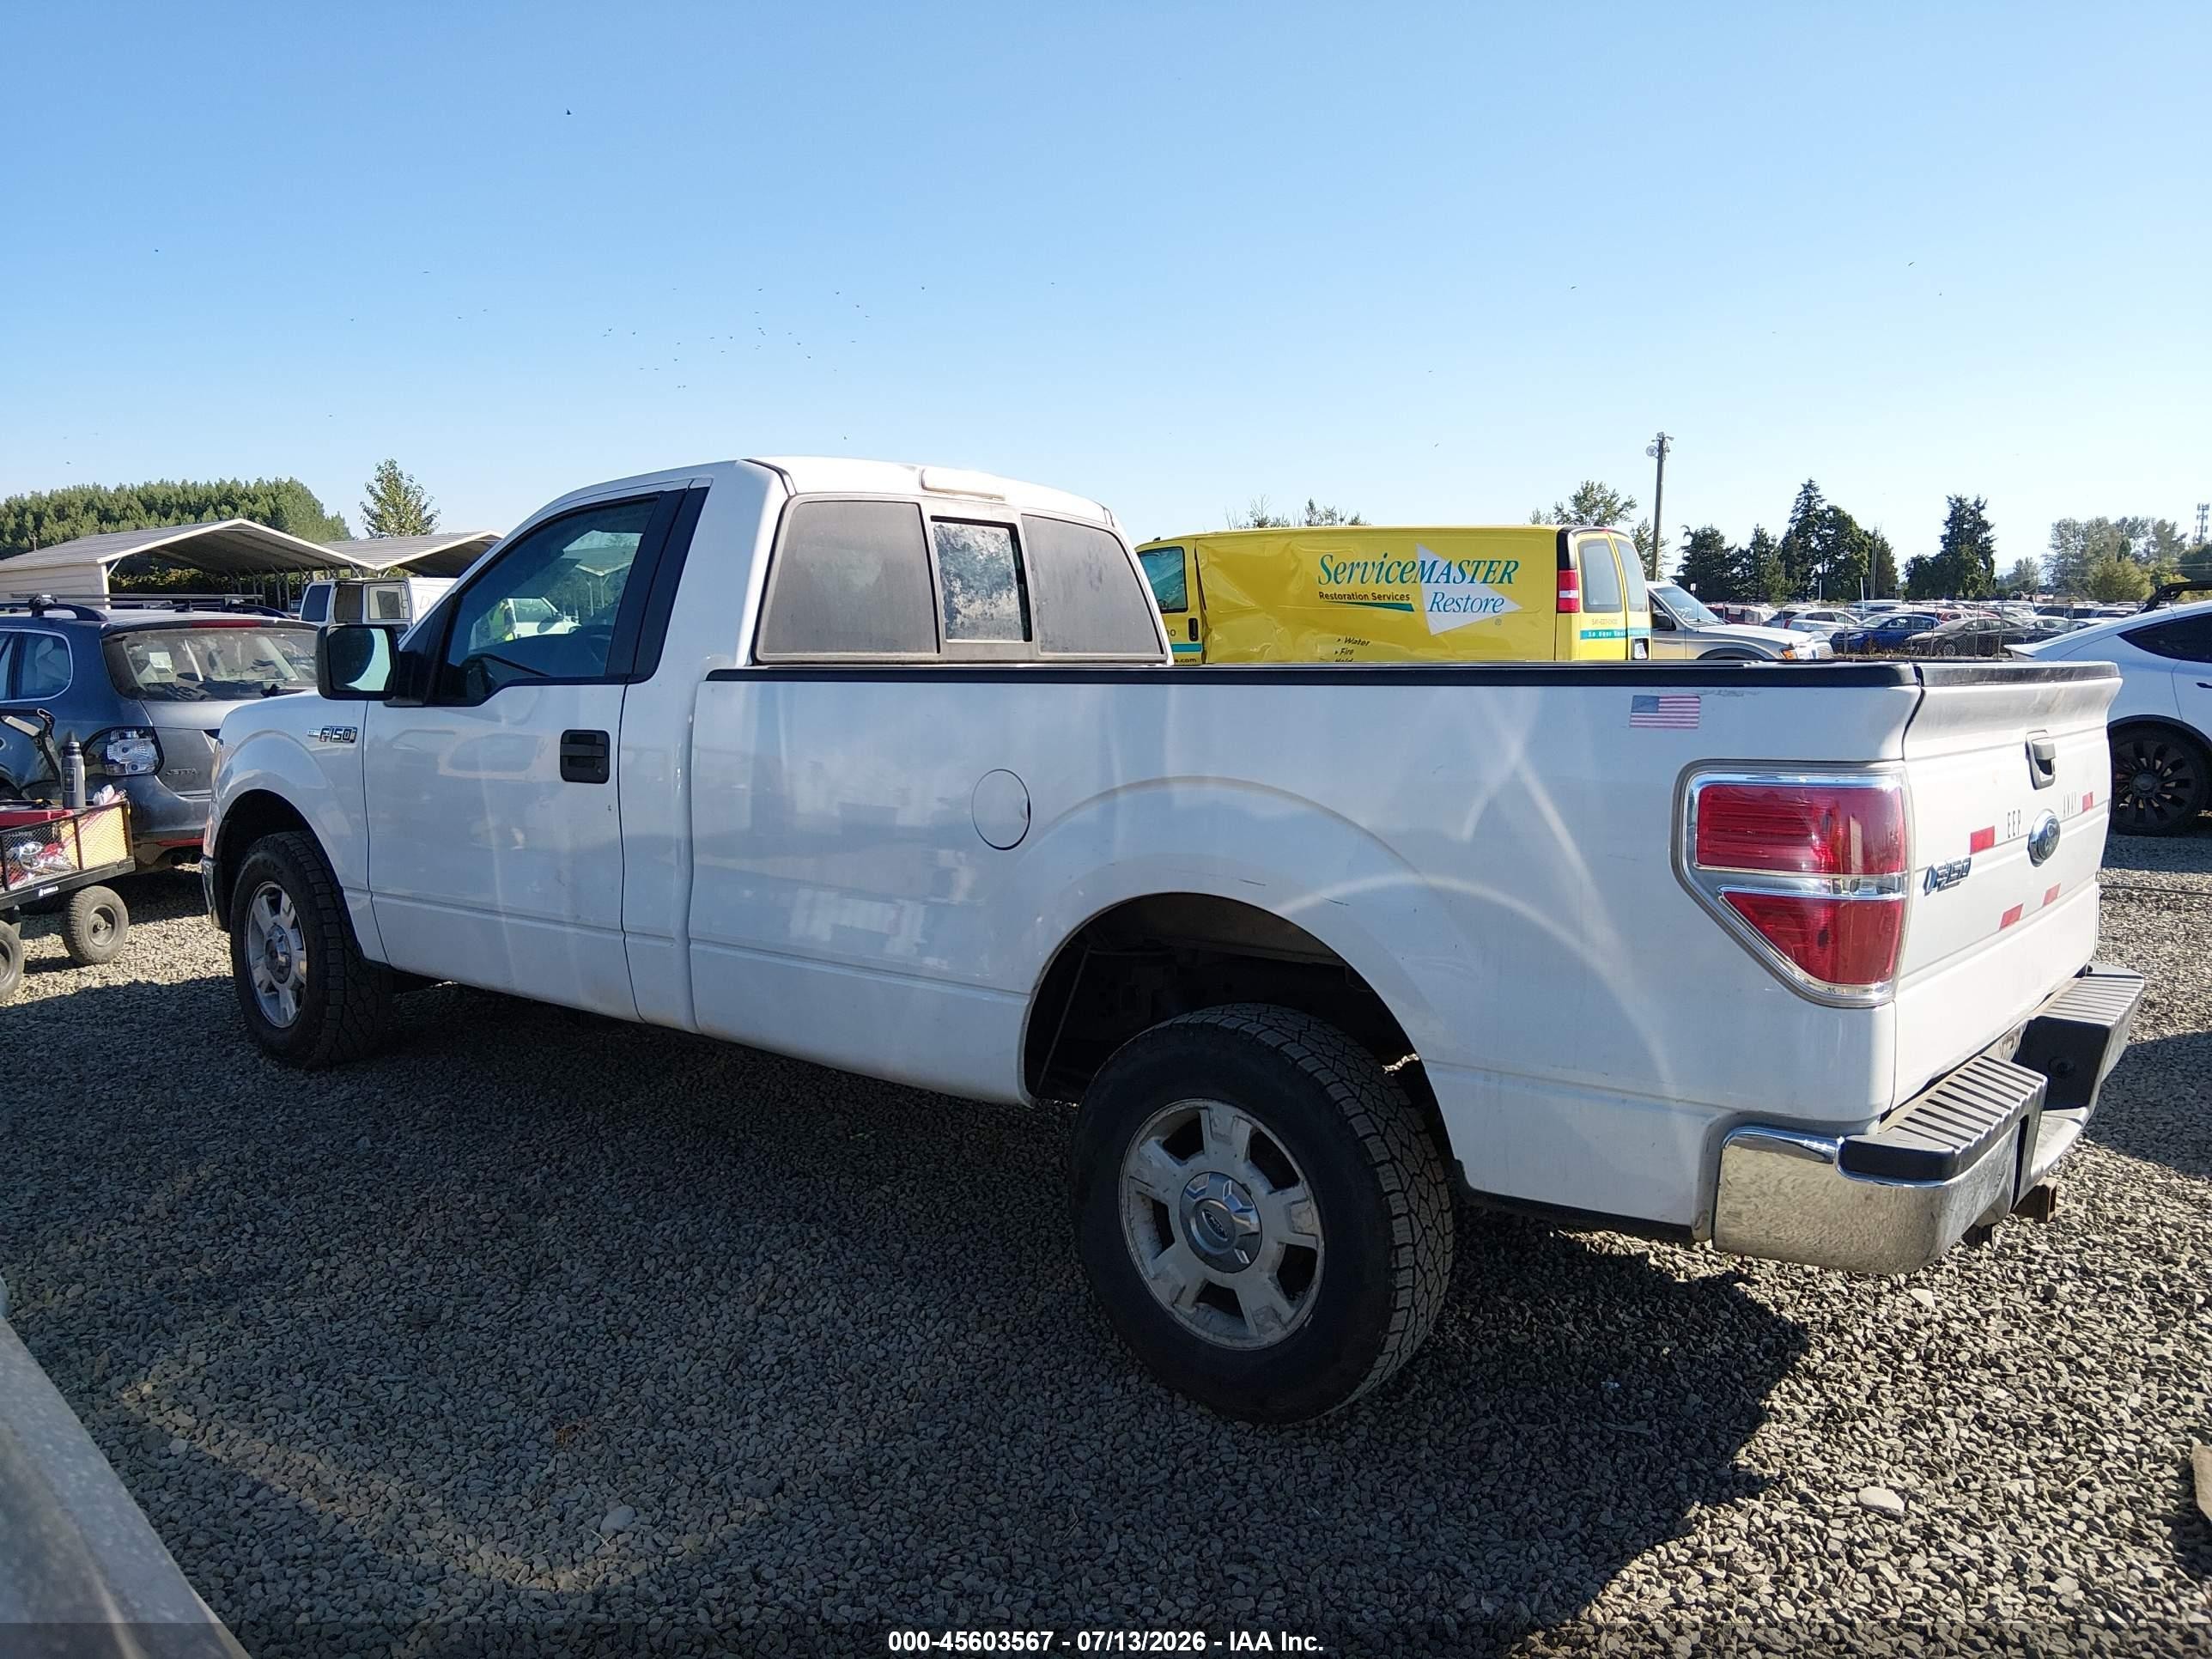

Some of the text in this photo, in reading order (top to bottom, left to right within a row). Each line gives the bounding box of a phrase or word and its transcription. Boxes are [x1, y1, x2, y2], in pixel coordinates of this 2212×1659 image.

[1318, 552, 1519, 586] ServiceMASTER
[1319, 591, 1411, 601] Restoration Services
[1427, 591, 1504, 613] Restore
[1344, 636, 1370, 647] Water
[1340, 647, 1354, 656] Fire
